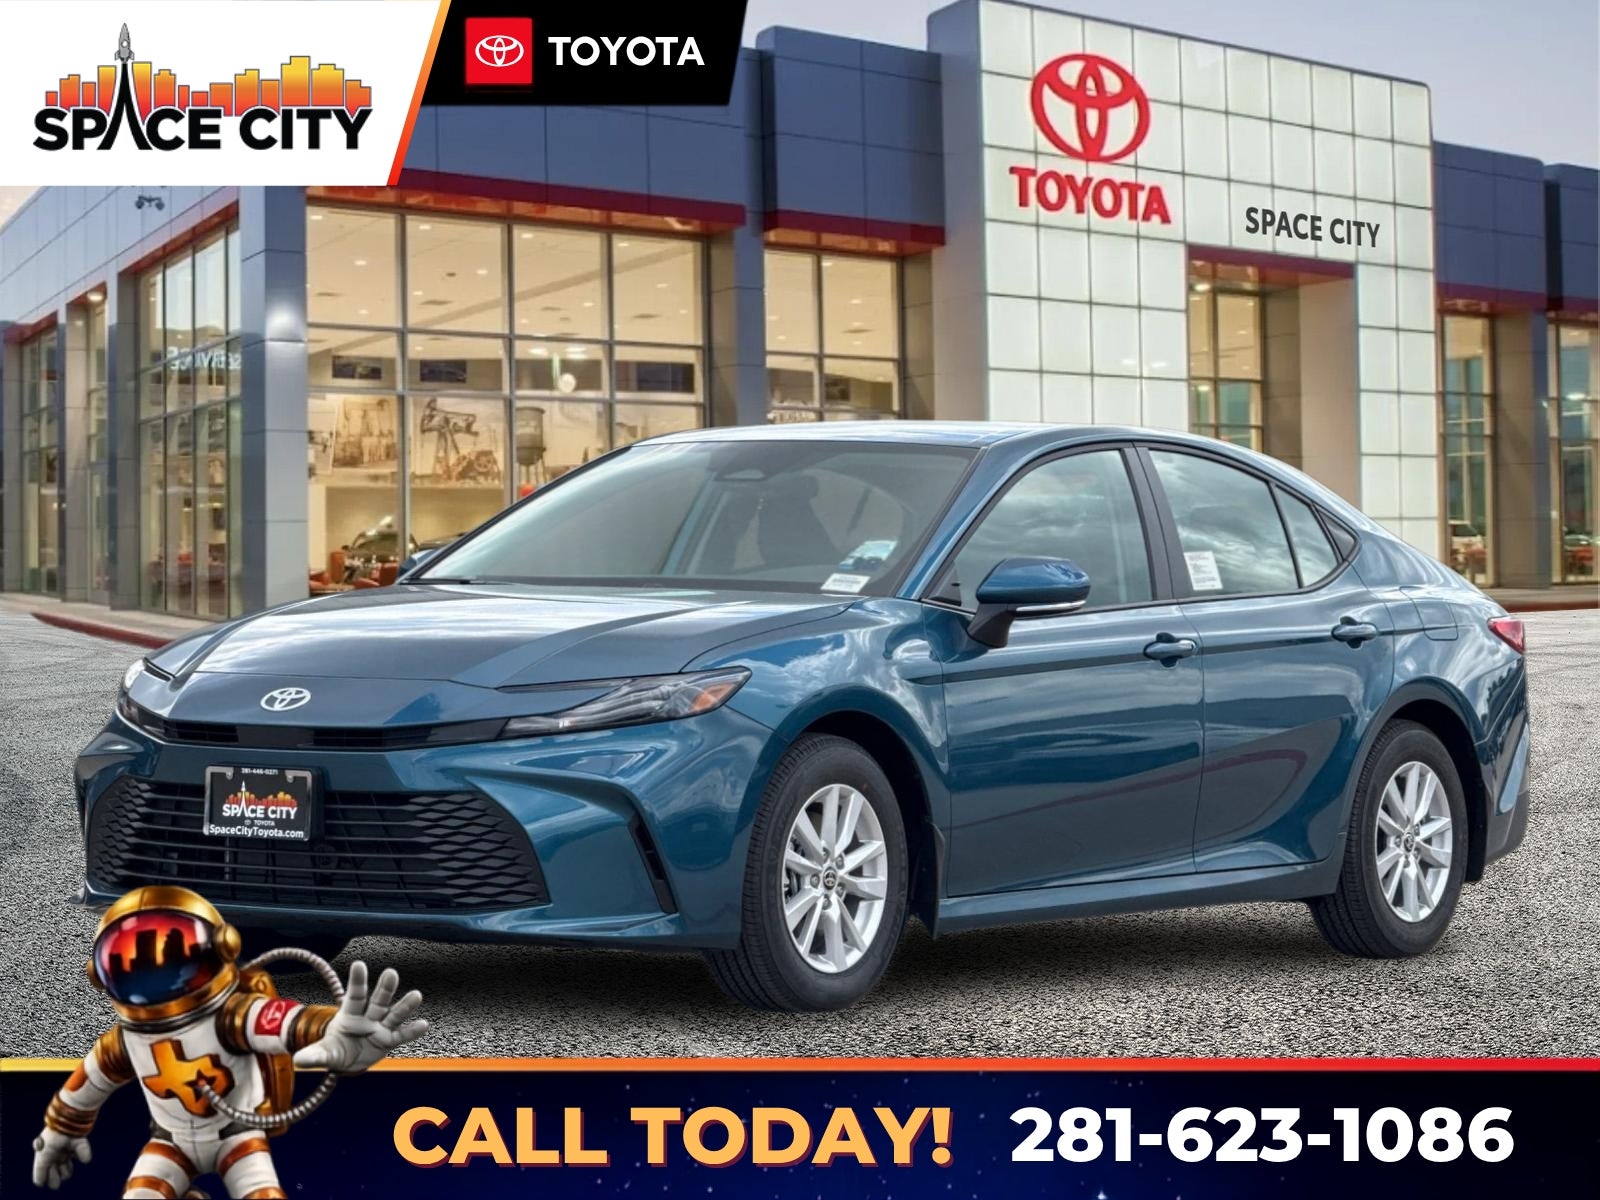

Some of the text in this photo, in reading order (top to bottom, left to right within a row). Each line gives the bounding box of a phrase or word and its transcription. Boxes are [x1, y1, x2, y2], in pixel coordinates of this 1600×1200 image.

[1009, 165, 1171, 224] TOYOTA
[1245, 206, 1381, 248] SPACE CITY
[222, 803, 297, 820] SPACE CITY
[209, 824, 304, 839] SpaceCityToyota.com
